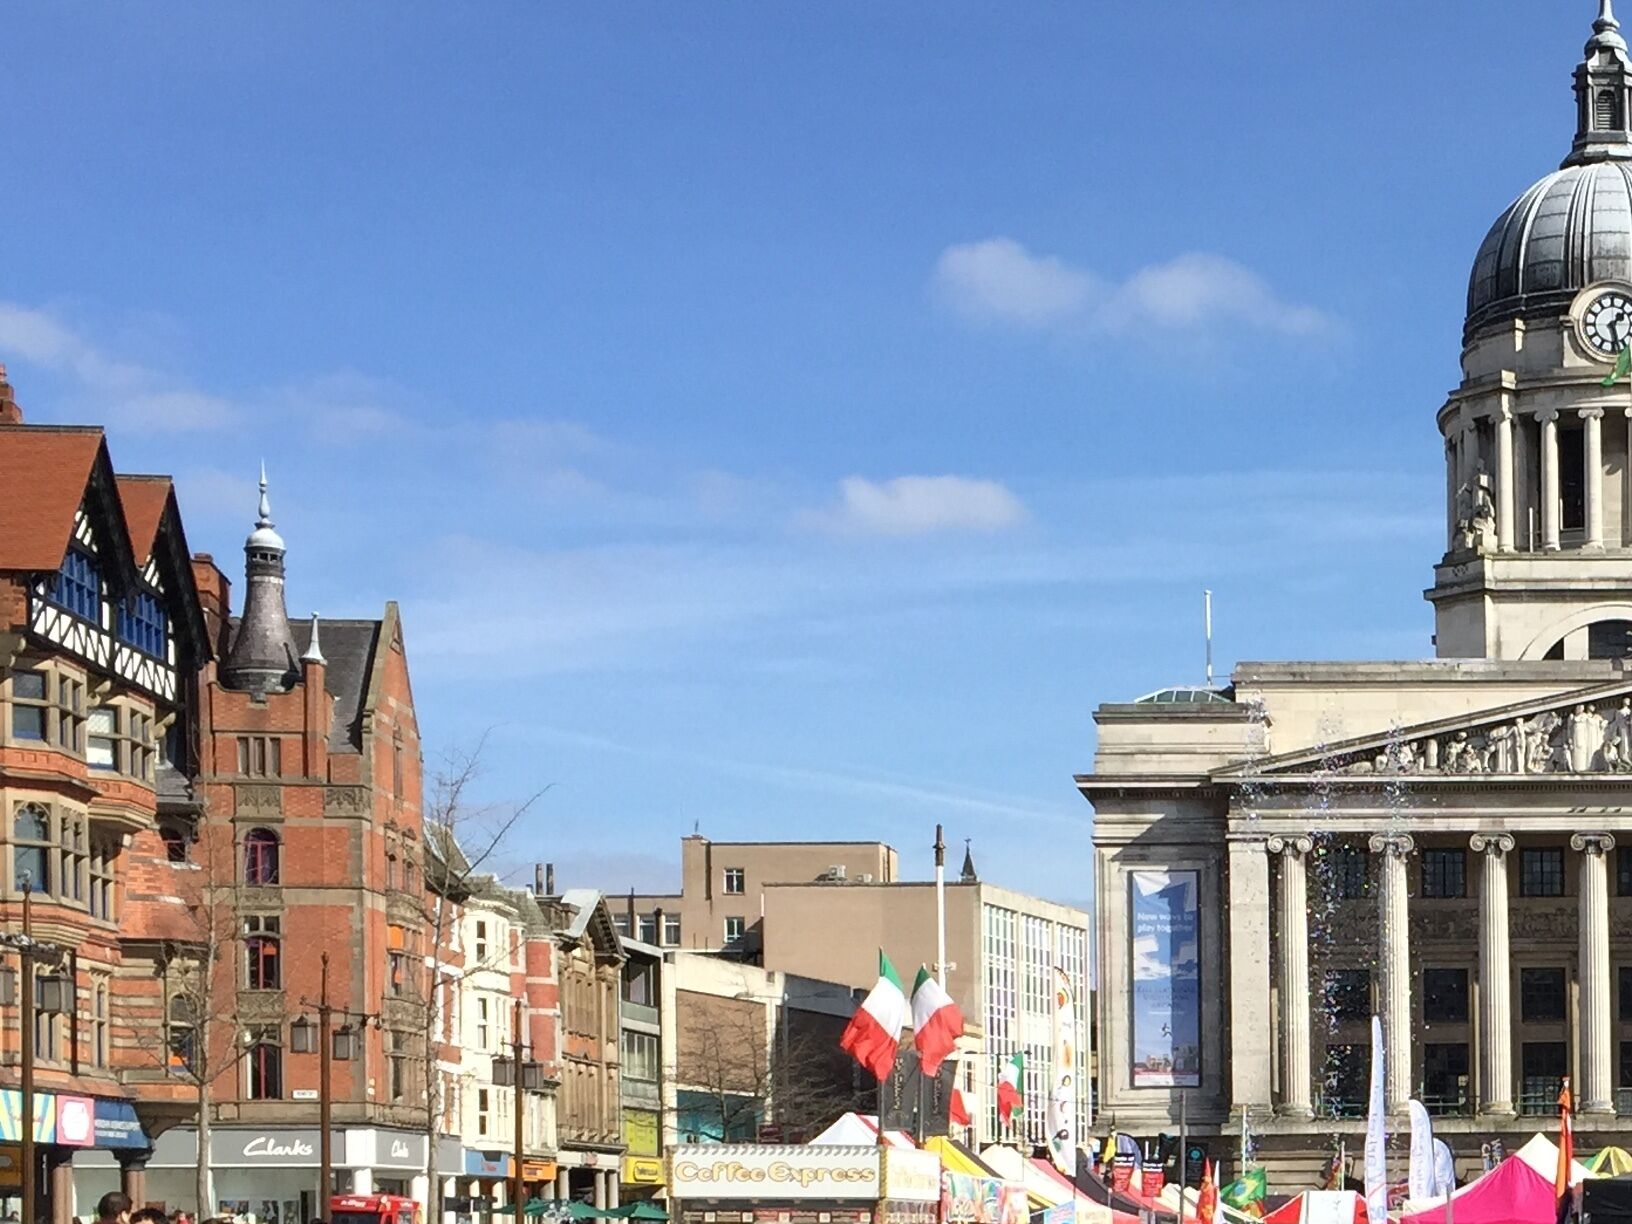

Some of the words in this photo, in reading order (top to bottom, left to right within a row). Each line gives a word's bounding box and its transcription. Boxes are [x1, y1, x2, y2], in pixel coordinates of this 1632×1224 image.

[1137, 913, 1157, 921] New
[243, 1137, 313, 1157] Clarks
[674, 1161, 766, 1182] Coffee
[767, 1161, 876, 1188] Express
